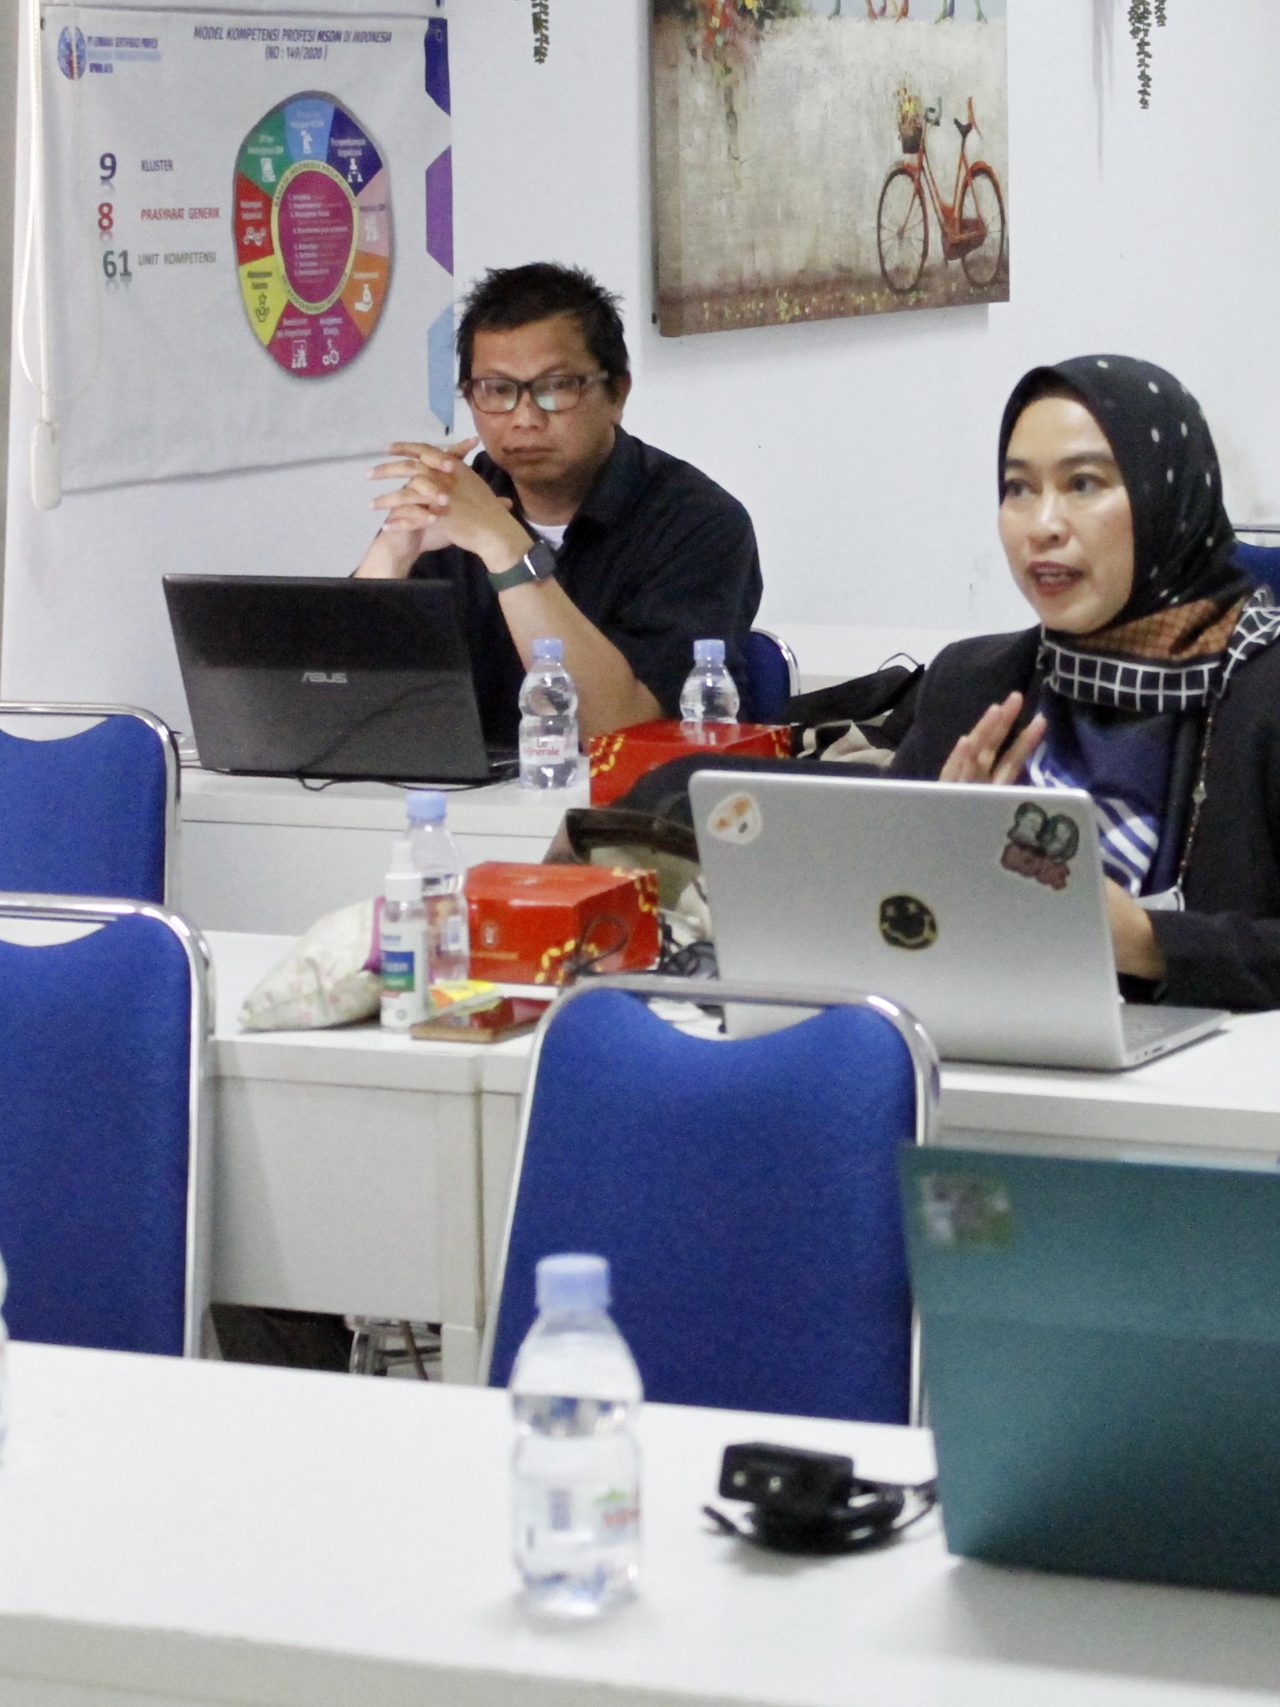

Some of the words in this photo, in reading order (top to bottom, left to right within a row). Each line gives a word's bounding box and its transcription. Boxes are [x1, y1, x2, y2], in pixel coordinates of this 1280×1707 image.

[193, 26, 224, 40] MODEL
[226, 27, 280, 41] KOMPETENSI
[281, 28, 317, 42] PROFESI
[99, 152, 117, 181] 9
[141, 159, 174, 172] KLUSTER
[97, 202, 114, 231] 8
[140, 208, 185, 221] PRASYARAT
[188, 207, 220, 220] GENERIK
[102, 249, 132, 278] 61
[138, 253, 160, 266] UNIT
[163, 251, 217, 265] KOMPETENSI
[301, 671, 348, 684] ASUS
